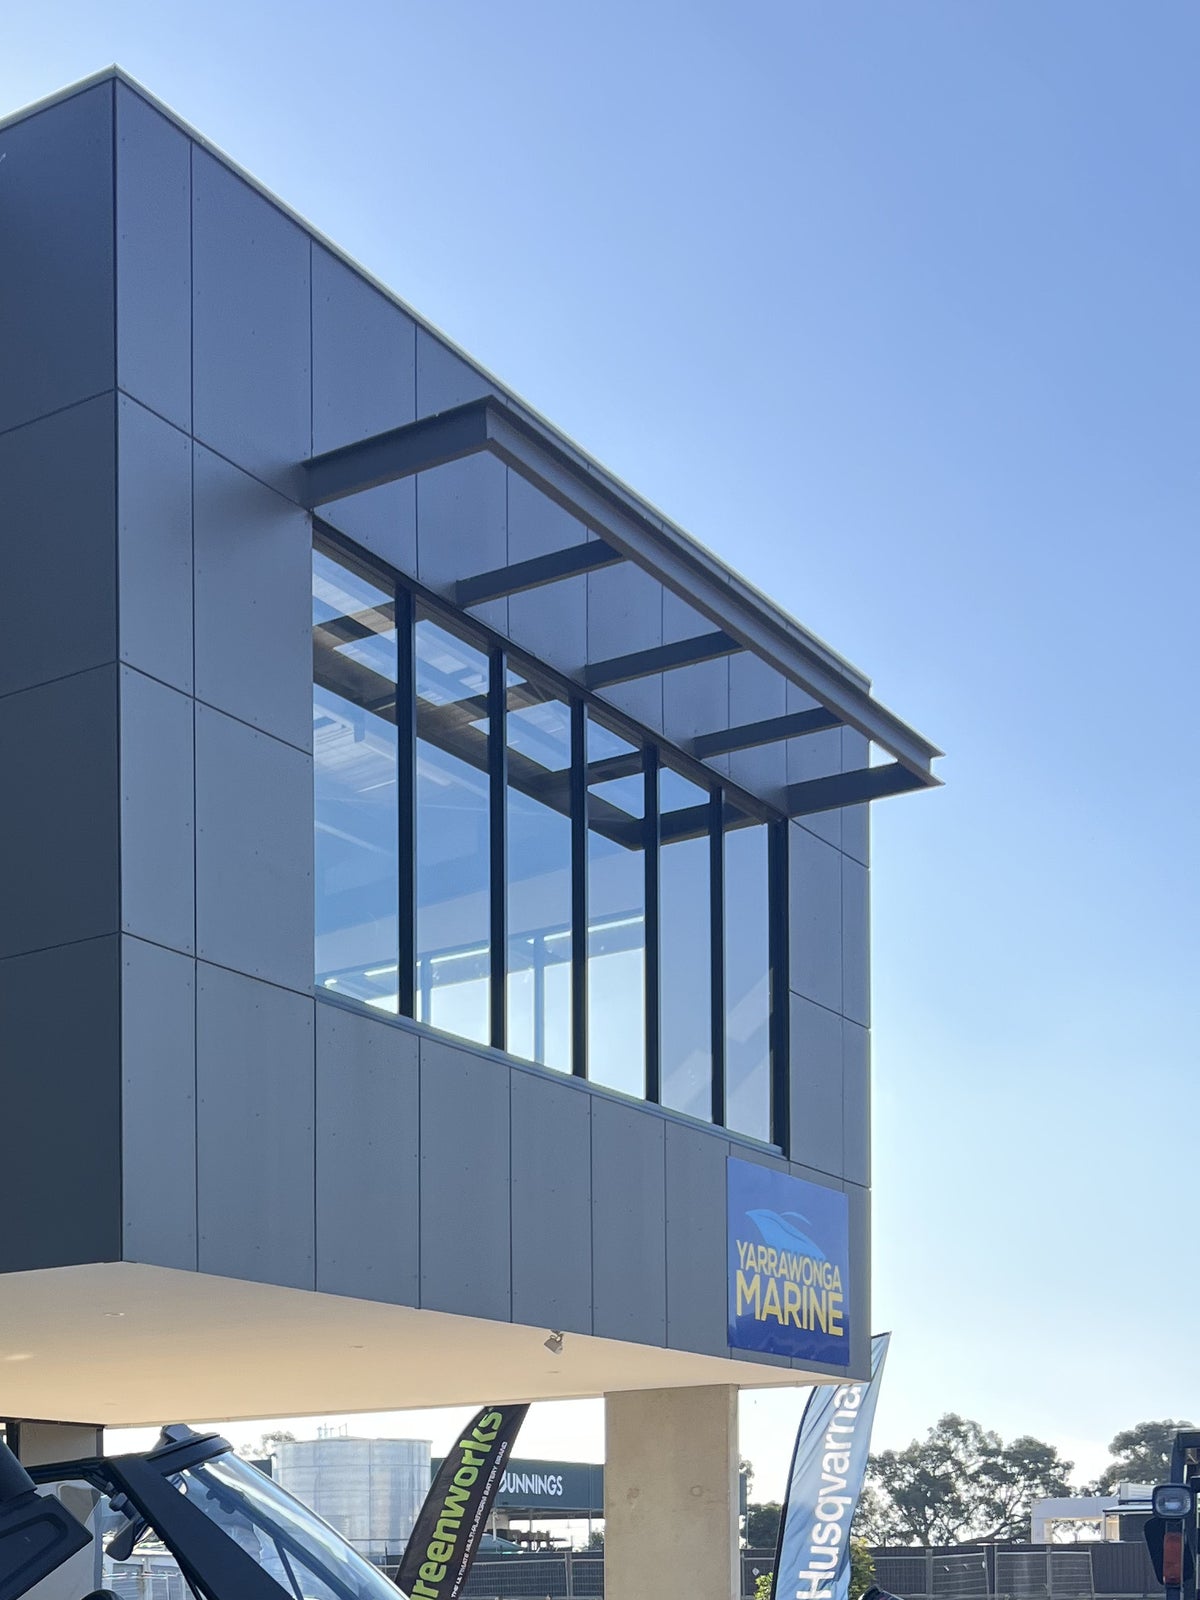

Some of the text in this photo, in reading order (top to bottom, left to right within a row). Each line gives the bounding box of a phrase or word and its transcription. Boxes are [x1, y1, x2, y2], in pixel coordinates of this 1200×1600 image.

[736, 1239, 842, 1293] YARRAWONGA
[736, 1269, 844, 1336] MARINE
[483, 1465, 498, 1496] BATTERY
[795, 1386, 862, 1600] Husqvarna
